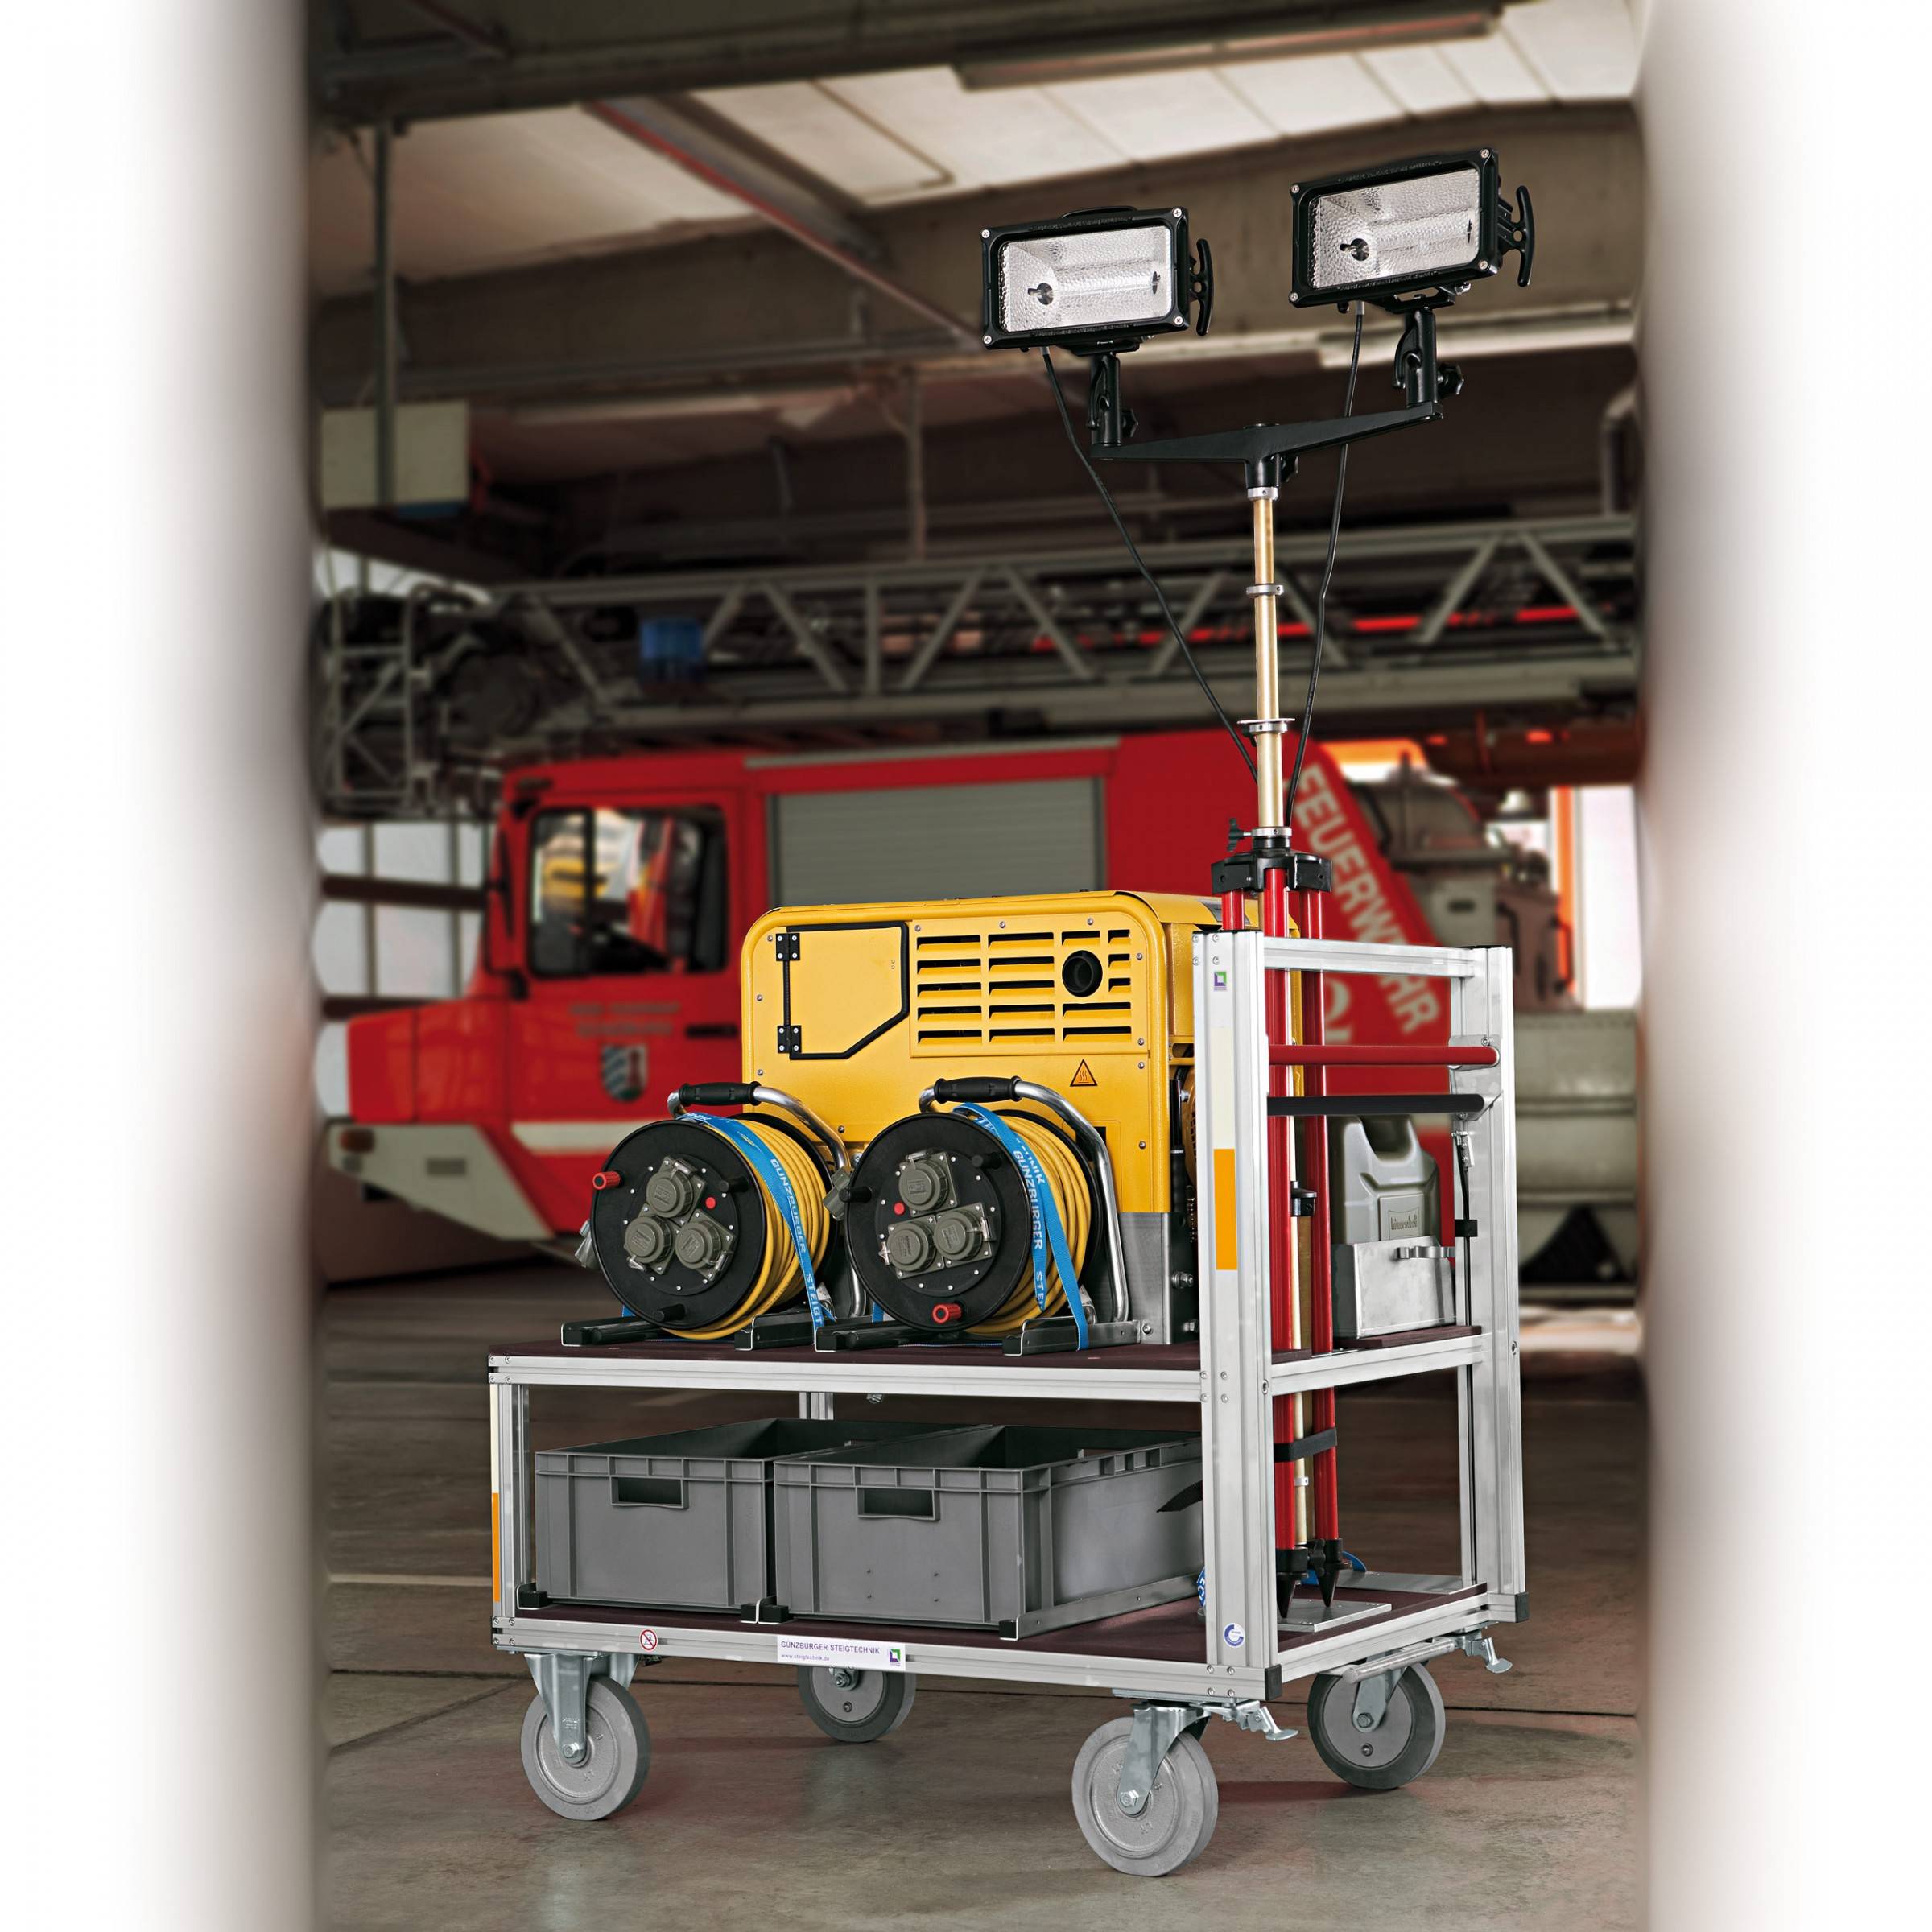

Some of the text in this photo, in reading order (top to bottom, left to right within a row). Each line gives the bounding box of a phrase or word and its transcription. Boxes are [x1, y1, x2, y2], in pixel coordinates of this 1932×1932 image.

[1286, 762, 1439, 1035] FEUERWHR
[830, 1643, 880, 1654] STEIGTECHNIK
[781, 1653, 830, 1662] www.steigtechnik.de
